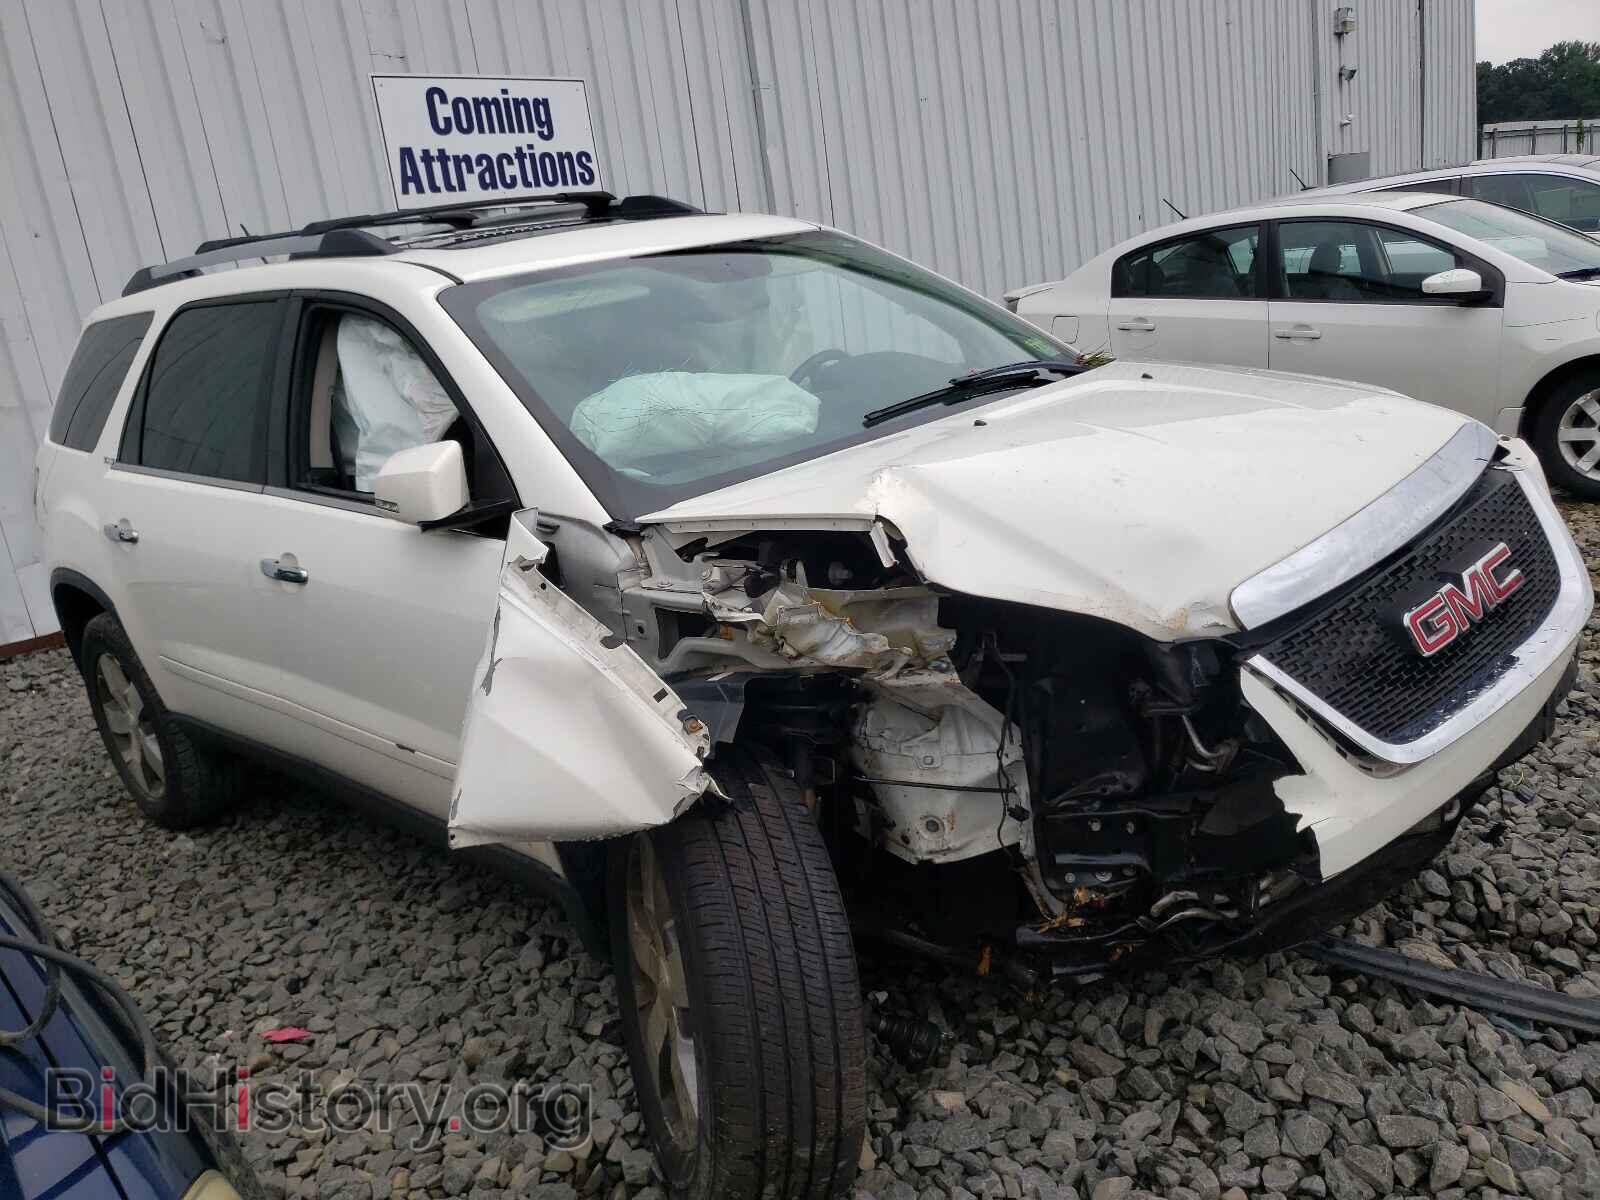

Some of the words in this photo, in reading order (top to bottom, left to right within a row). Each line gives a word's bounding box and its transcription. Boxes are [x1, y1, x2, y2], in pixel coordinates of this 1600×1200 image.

[426, 87, 554, 141] Coming
[400, 144, 595, 195] Attractions
[1403, 542, 1525, 657] GMC
